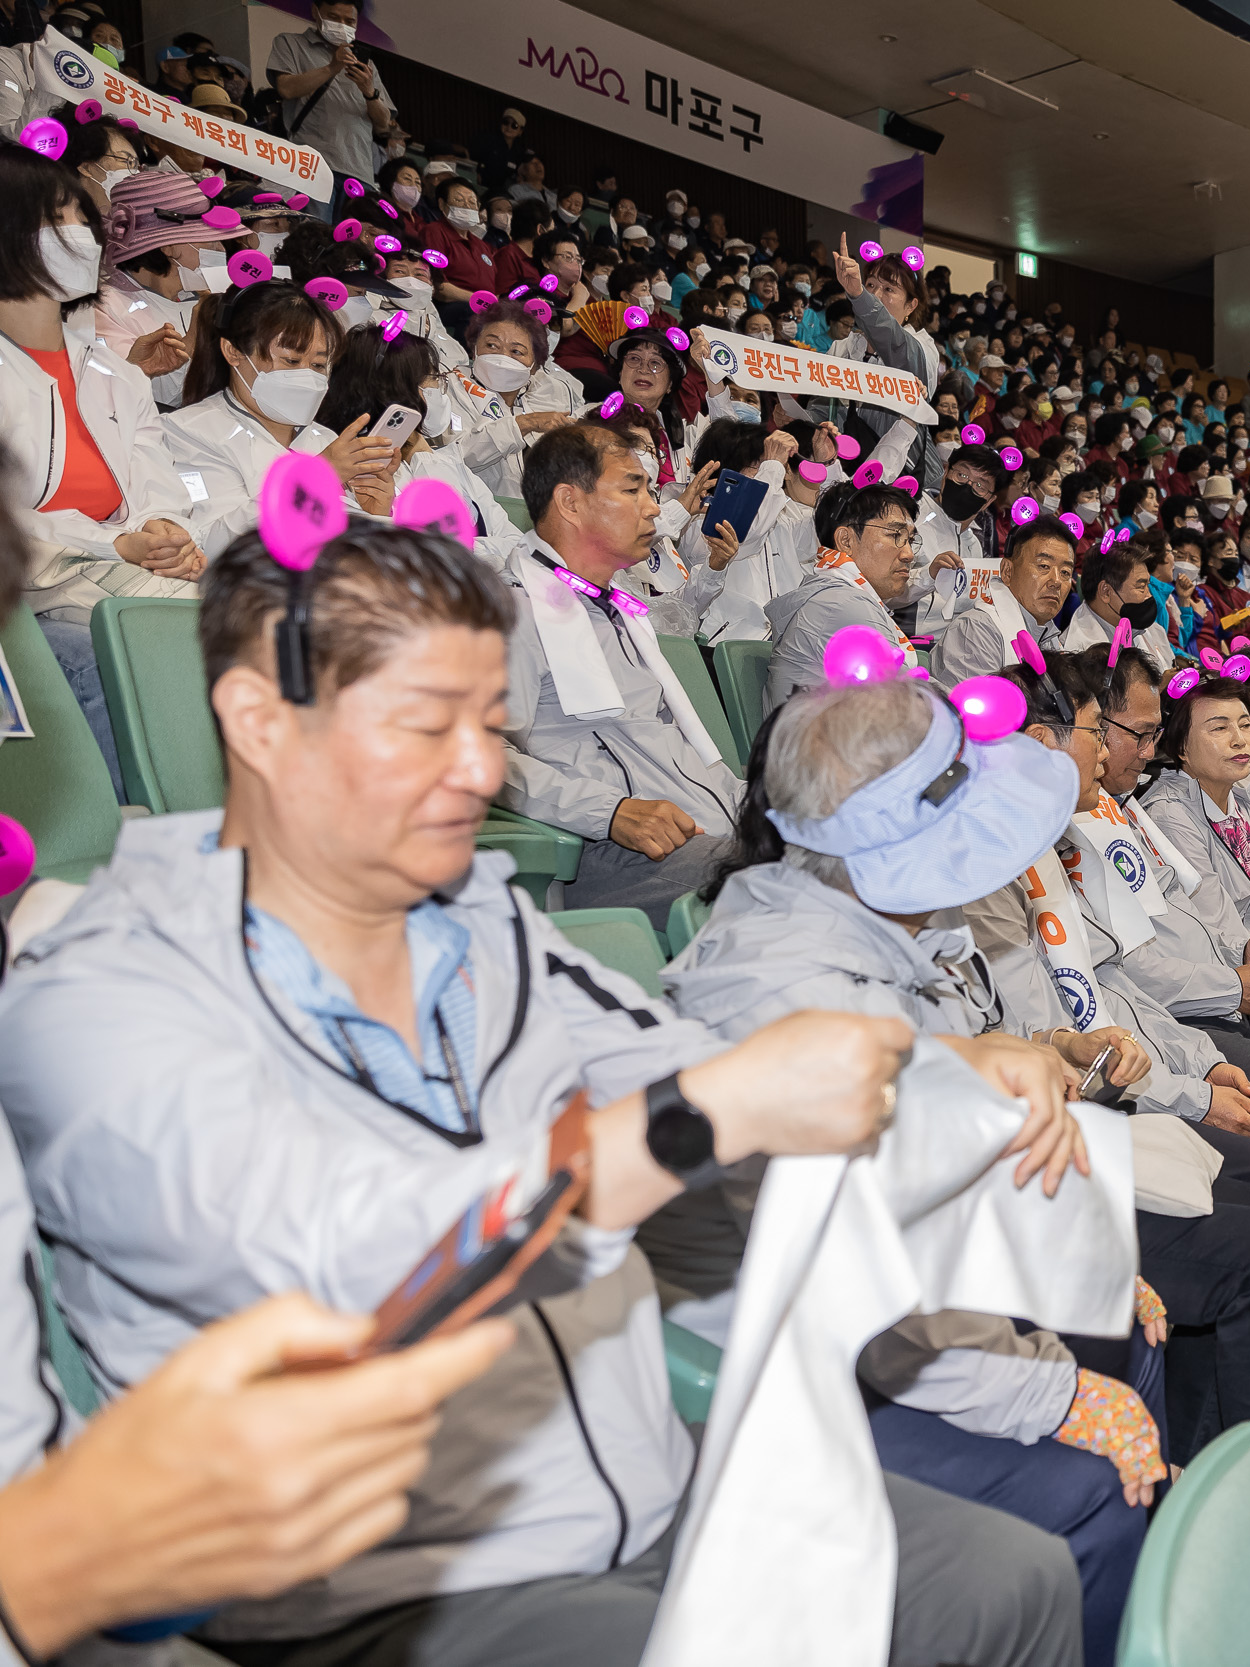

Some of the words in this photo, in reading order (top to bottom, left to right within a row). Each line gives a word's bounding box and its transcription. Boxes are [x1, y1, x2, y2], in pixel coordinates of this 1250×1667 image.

[645, 69, 764, 153] 마포구
[103, 72, 175, 123] 광진구
[181, 111, 248, 155] 체육회
[254, 138, 320, 181] 화이팅!
[37, 136, 58, 151] 광진
[240, 261, 261, 279] 광진
[317, 291, 339, 303] 광진
[530, 307, 546, 317] 광진
[744, 347, 801, 383] 광진구
[807, 360, 863, 394] 체육회
[865, 372, 920, 405] 화이팅!
[1006, 454, 1019, 463] 광진
[1020, 504, 1033, 519] 광진
[1230, 666, 1247, 680] 광진
